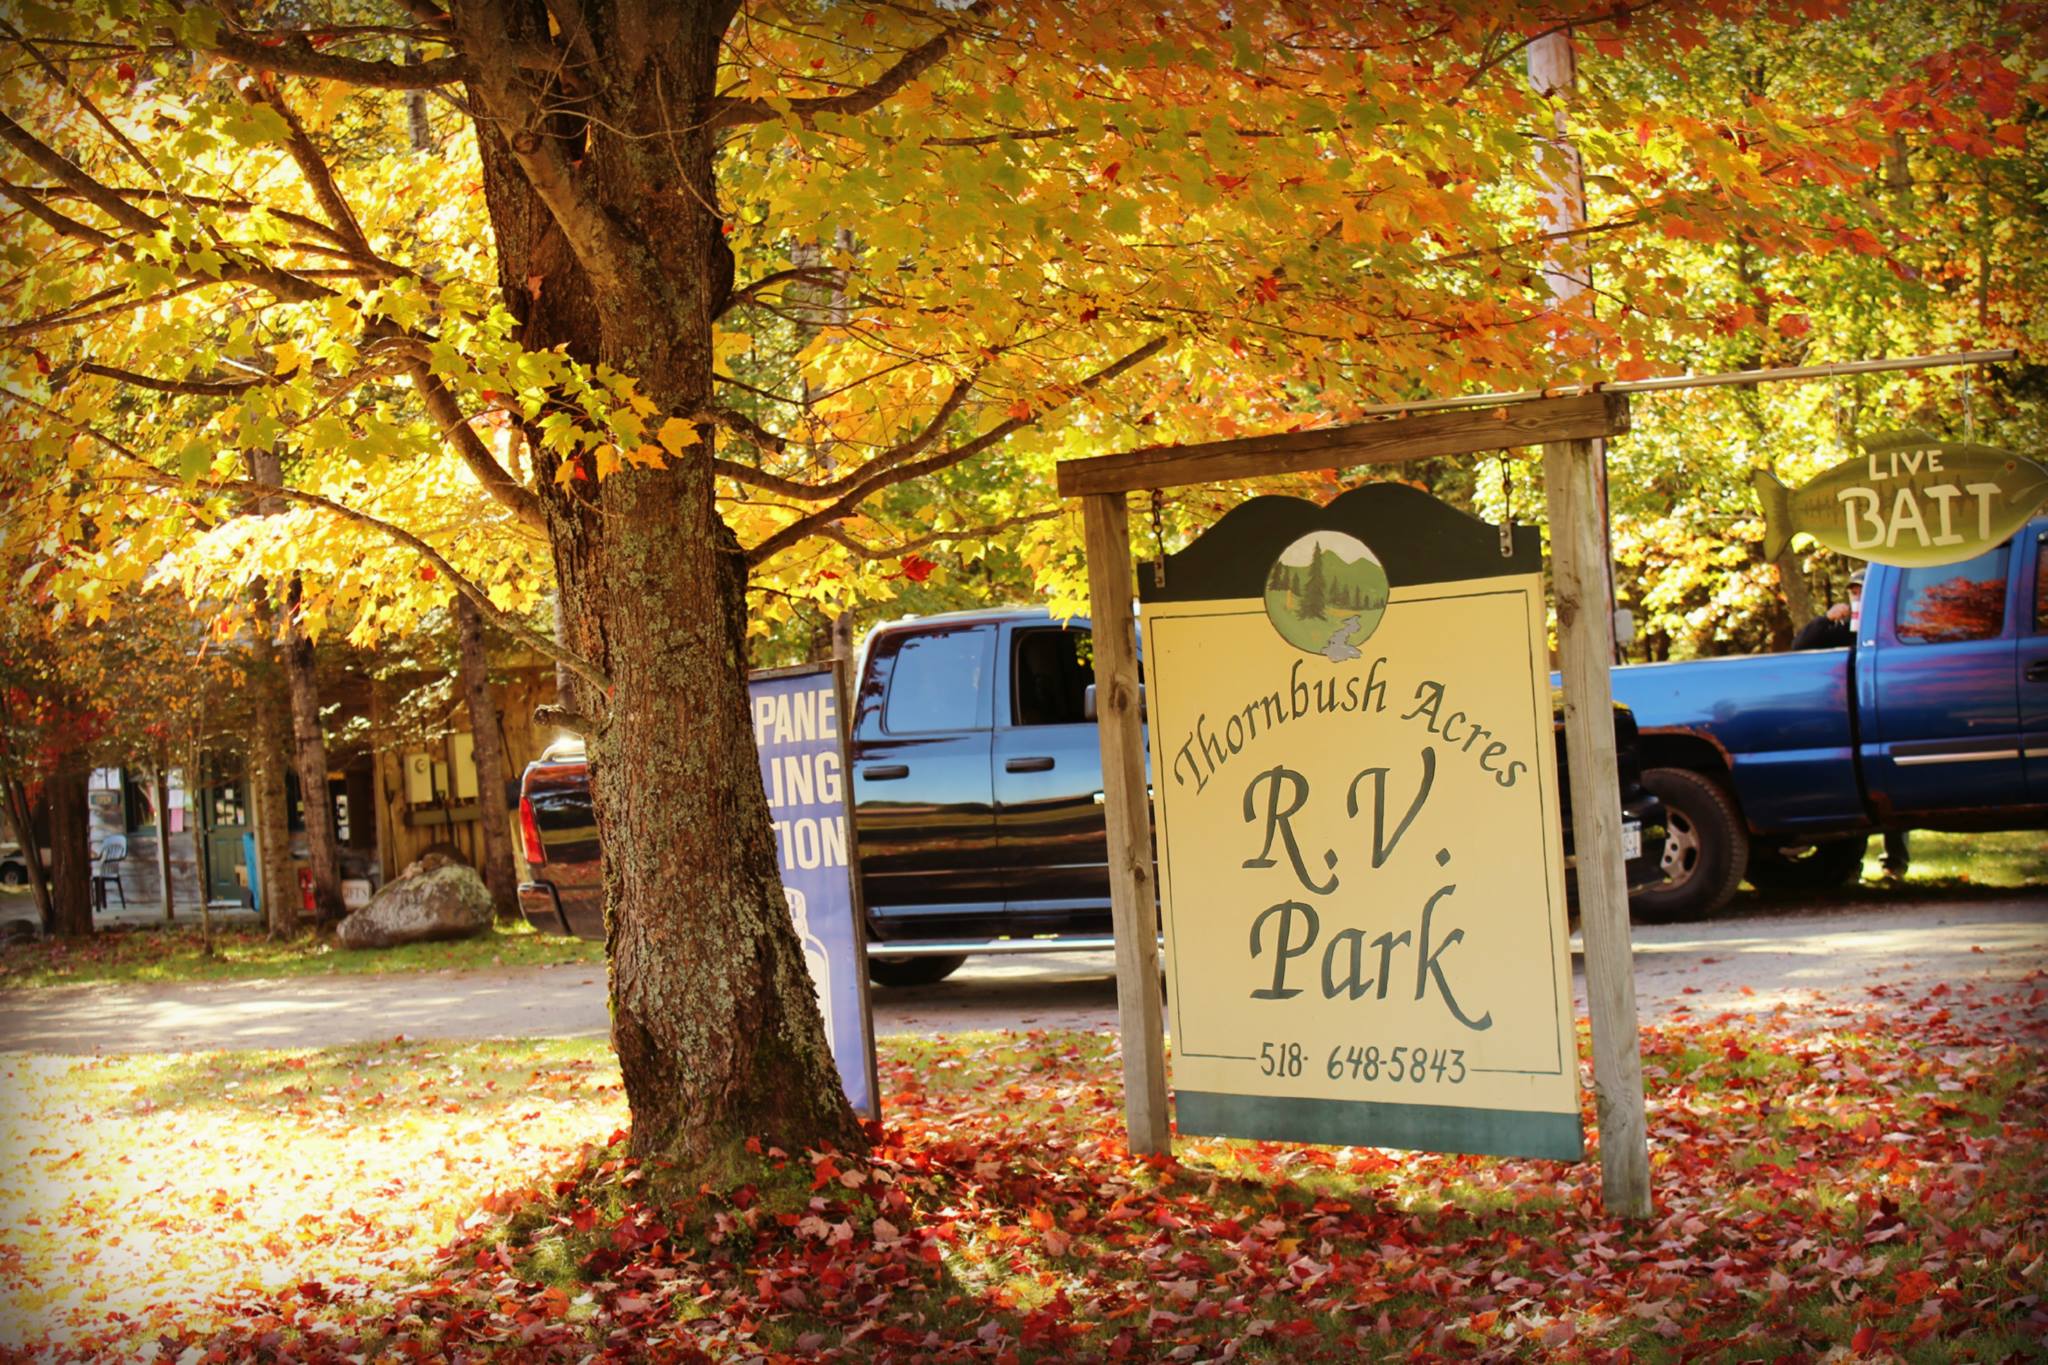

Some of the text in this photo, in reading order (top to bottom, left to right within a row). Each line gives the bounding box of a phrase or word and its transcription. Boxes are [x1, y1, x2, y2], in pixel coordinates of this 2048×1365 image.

[1869, 450, 1944, 480] LIVE
[1837, 483, 2002, 549] BAIT
[750, 688, 837, 746] PANE
[1174, 657, 1527, 796] Thornbush Acres
[767, 752, 843, 808] ING
[770, 816, 849, 871] ION
[1250, 884, 1493, 1031] Park
[1327, 1045, 1466, 1083] 648-5843
